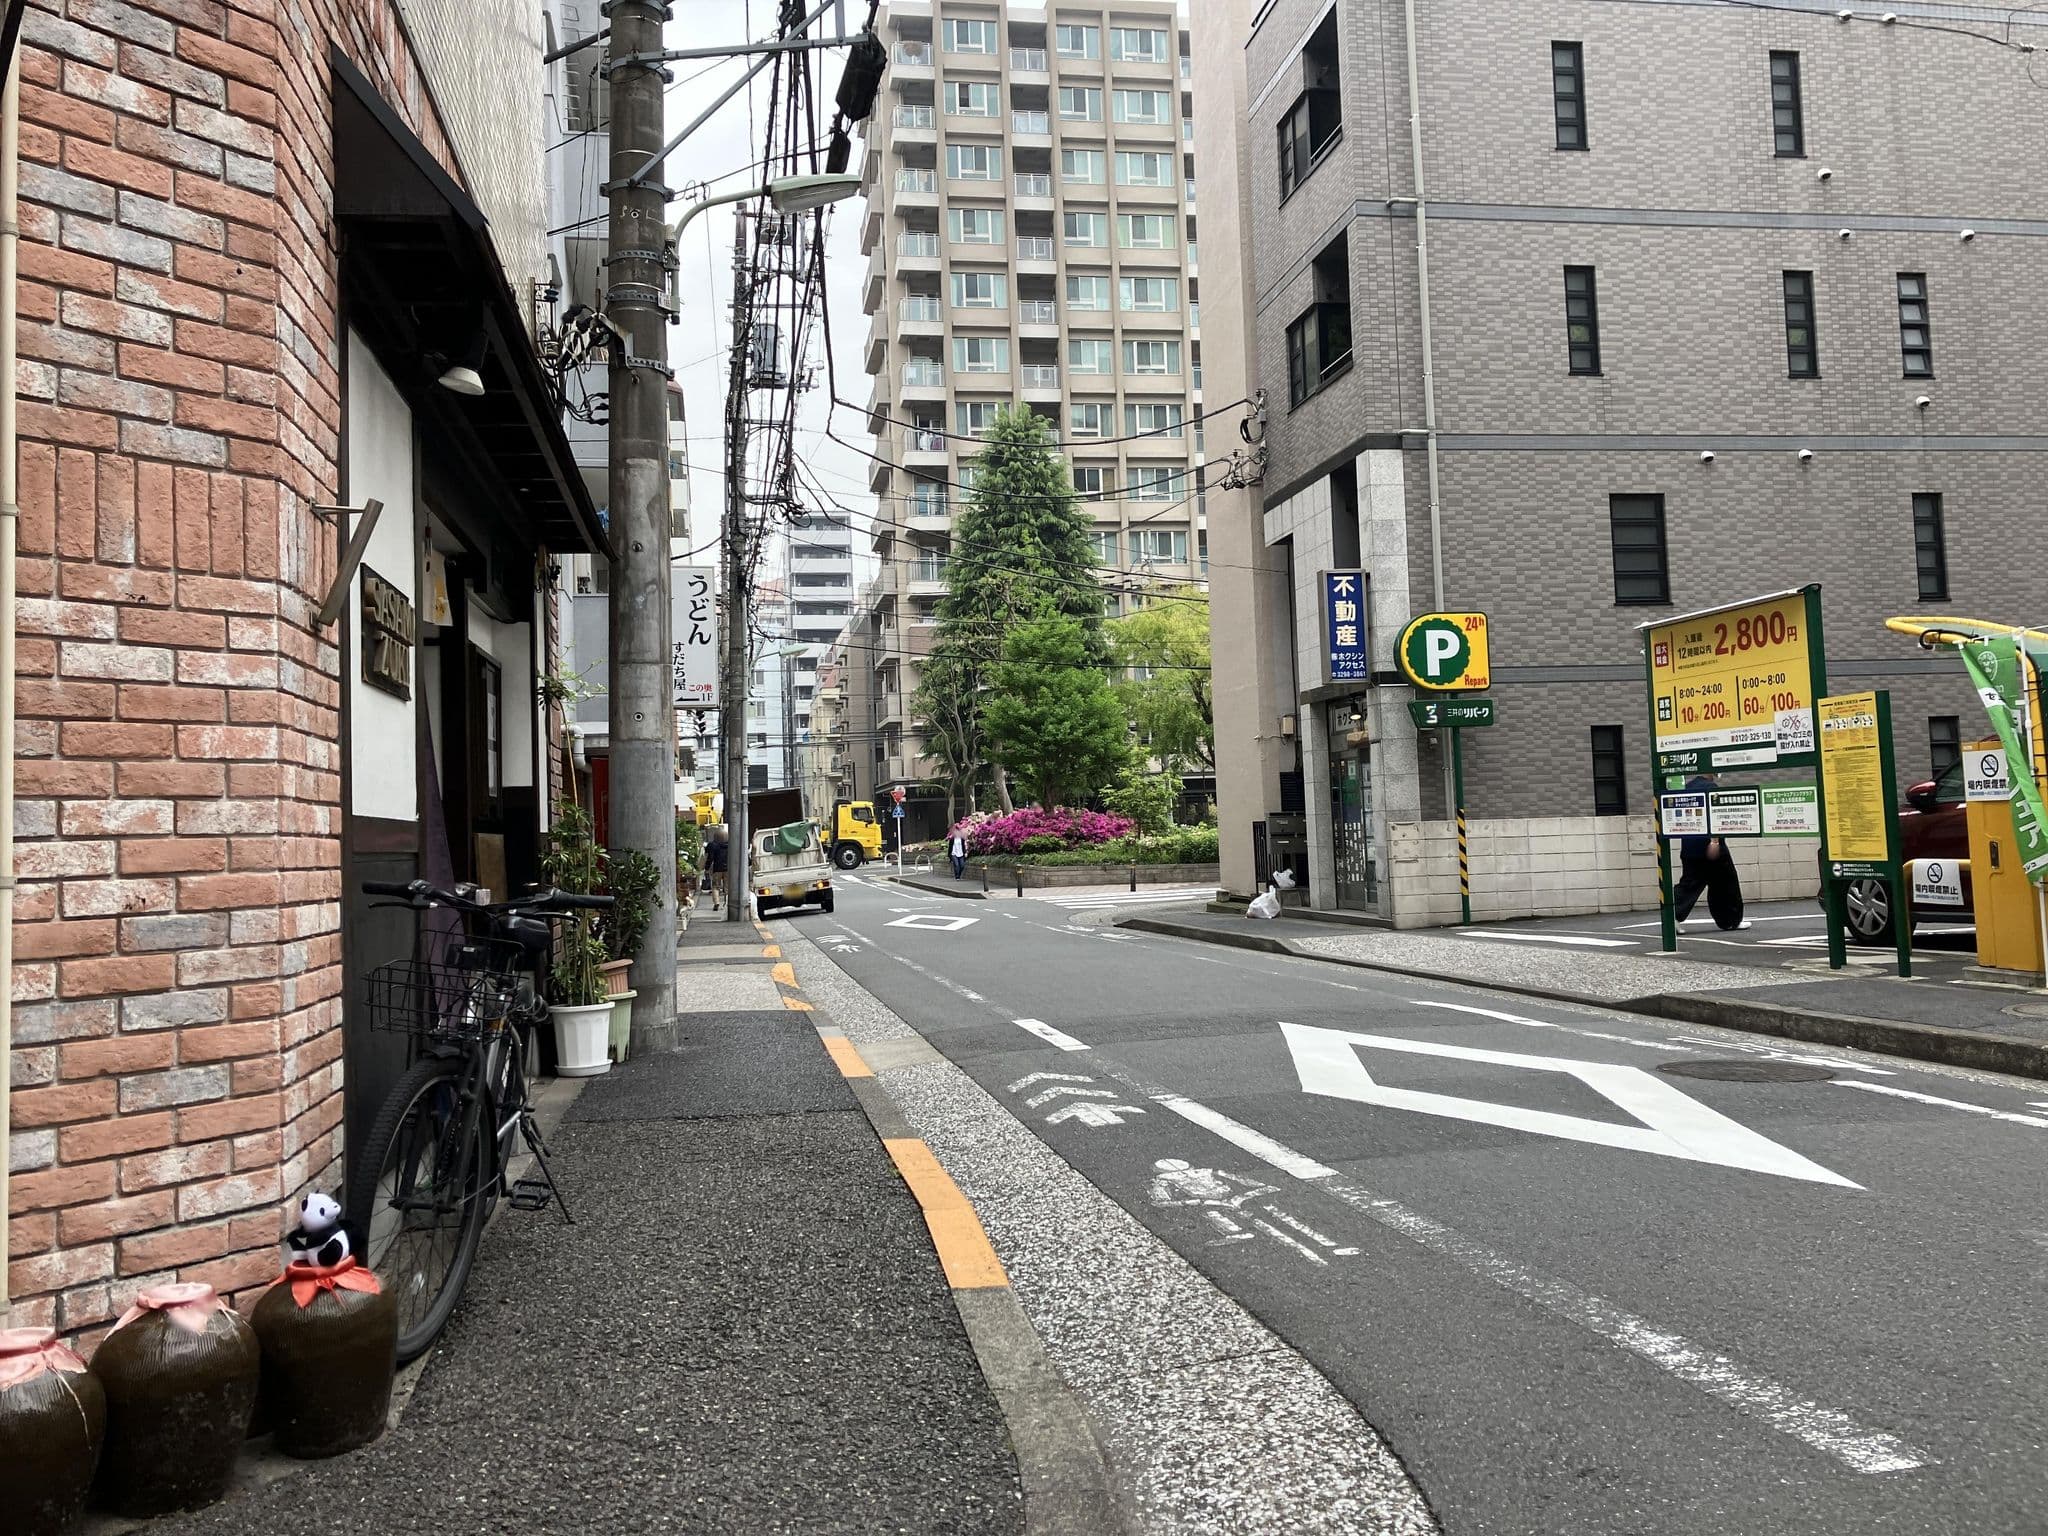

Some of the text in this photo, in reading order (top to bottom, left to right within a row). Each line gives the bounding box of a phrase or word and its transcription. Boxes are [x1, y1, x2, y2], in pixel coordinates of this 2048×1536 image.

[688, 574, 712, 645] うどん
[1333, 576, 1358, 646] 不動産
[1465, 616, 1485, 631] 24h
[1425, 629, 1461, 676] P
[1677, 645, 1712, 659] 12時間以内
[672, 641, 686, 690] すだち屋
[1339, 661, 1365, 669] アクセス
[1464, 674, 1488, 686] Repark
[702, 693, 713, 702] 1F
